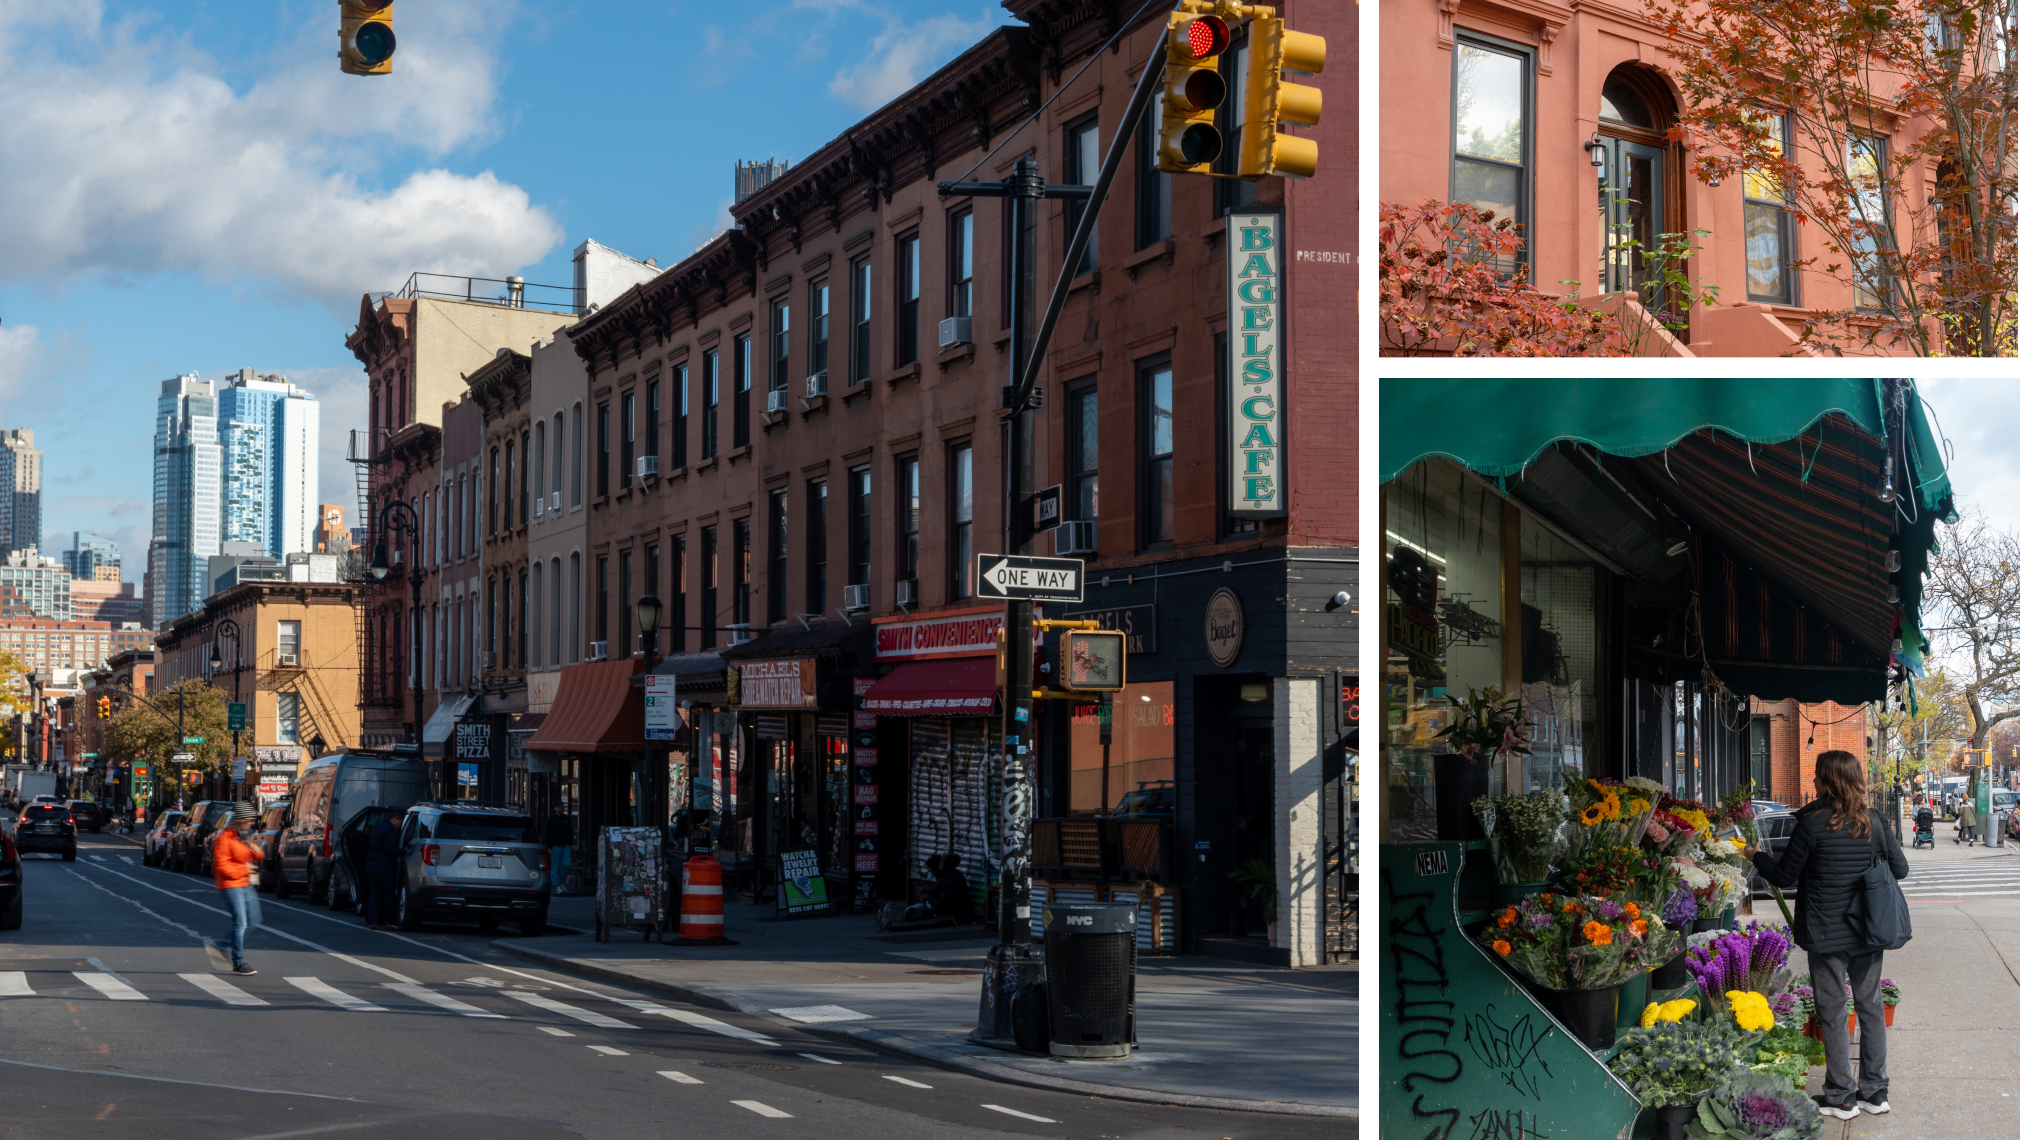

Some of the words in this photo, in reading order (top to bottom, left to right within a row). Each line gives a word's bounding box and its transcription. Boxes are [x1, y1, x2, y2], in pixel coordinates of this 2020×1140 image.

[1296, 250, 1351, 264] PRESIDENT
[1237, 226, 1276, 386] BAGELS
[1239, 395, 1277, 501] CAFE
[997, 568, 1029, 587] ONE
[1036, 570, 1069, 588] WAY
[877, 626, 913, 652] SMITH
[914, 617, 1001, 649] CONVENIENCE
[1210, 618, 1236, 647] Bagel
[1391, 604, 1439, 657] PACIFICO
[741, 660, 801, 679] MICHAEL'S
[780, 678, 802, 705] REPAIR
[648, 697, 654, 707] 2
[456, 723, 491, 736] SMITH
[456, 736, 490, 746] STREET
[456, 746, 491, 759] PIZZA
[858, 787, 875, 796] BAG
[783, 858, 818, 870] JEWELRY
[856, 860, 877, 870] HERE
[1416, 850, 1448, 875] NEMA
[784, 866, 821, 880] REPAIR
[789, 906, 802, 914] KEYS
[803, 904, 813, 912] CUT
[1066, 915, 1093, 926] NYC
